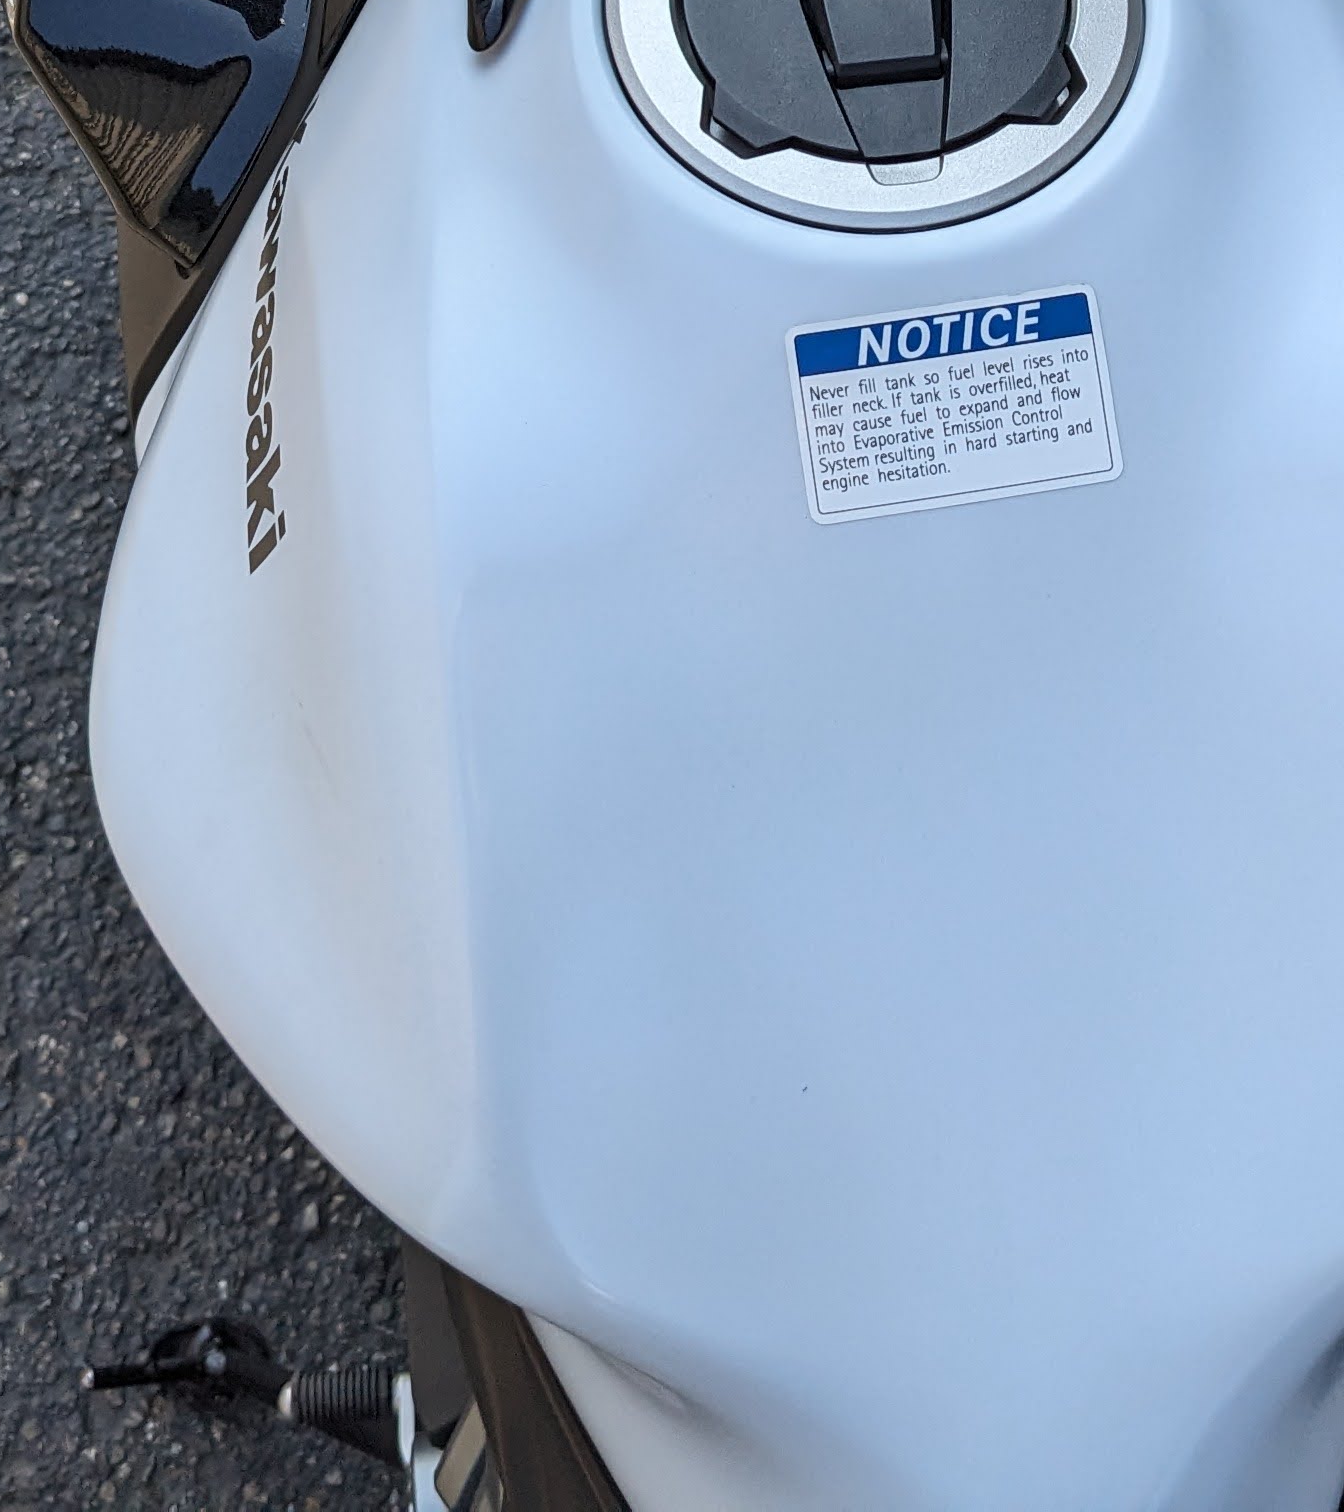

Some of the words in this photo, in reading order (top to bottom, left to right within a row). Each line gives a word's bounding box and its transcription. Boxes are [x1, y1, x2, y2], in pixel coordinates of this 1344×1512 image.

[858, 302, 1041, 367] NOTICE
[810, 385, 849, 401] Never
[859, 378, 876, 394] fill
[885, 373, 916, 391] tank
[924, 372, 940, 385] so
[948, 364, 975, 381] fuel
[983, 357, 1014, 376] level
[1023, 354, 1054, 370] rises
[1061, 348, 1089, 364] into
[812, 402, 843, 419] filler
[853, 396, 887, 414] neck.
[892, 392, 902, 408] If
[910, 387, 941, 406] tank
[949, 384, 961, 399] is
[969, 373, 1037, 396] overfilled,
[1040, 368, 1071, 386] heat
[815, 422, 844, 438] may
[853, 415, 893, 432] cause
[900, 407, 927, 425] fuel
[936, 406, 951, 420] to
[959, 394, 1008, 418] expand
[1017, 390, 1042, 408] and
[1051, 386, 1081, 402] flow
[817, 440, 845, 455] into
[853, 426, 935, 450] Evaporative
[943, 417, 1004, 437] Emission
[1012, 404, 1063, 426] Control
[819, 455, 870, 476] System
[874, 445, 936, 466] resulting
[943, 439, 957, 455] in
[965, 433, 997, 452] hard
[1006, 426, 1059, 446] starting
[1067, 418, 1093, 437] and
[822, 472, 870, 492] engine
[877, 460, 951, 483] hesitation.
